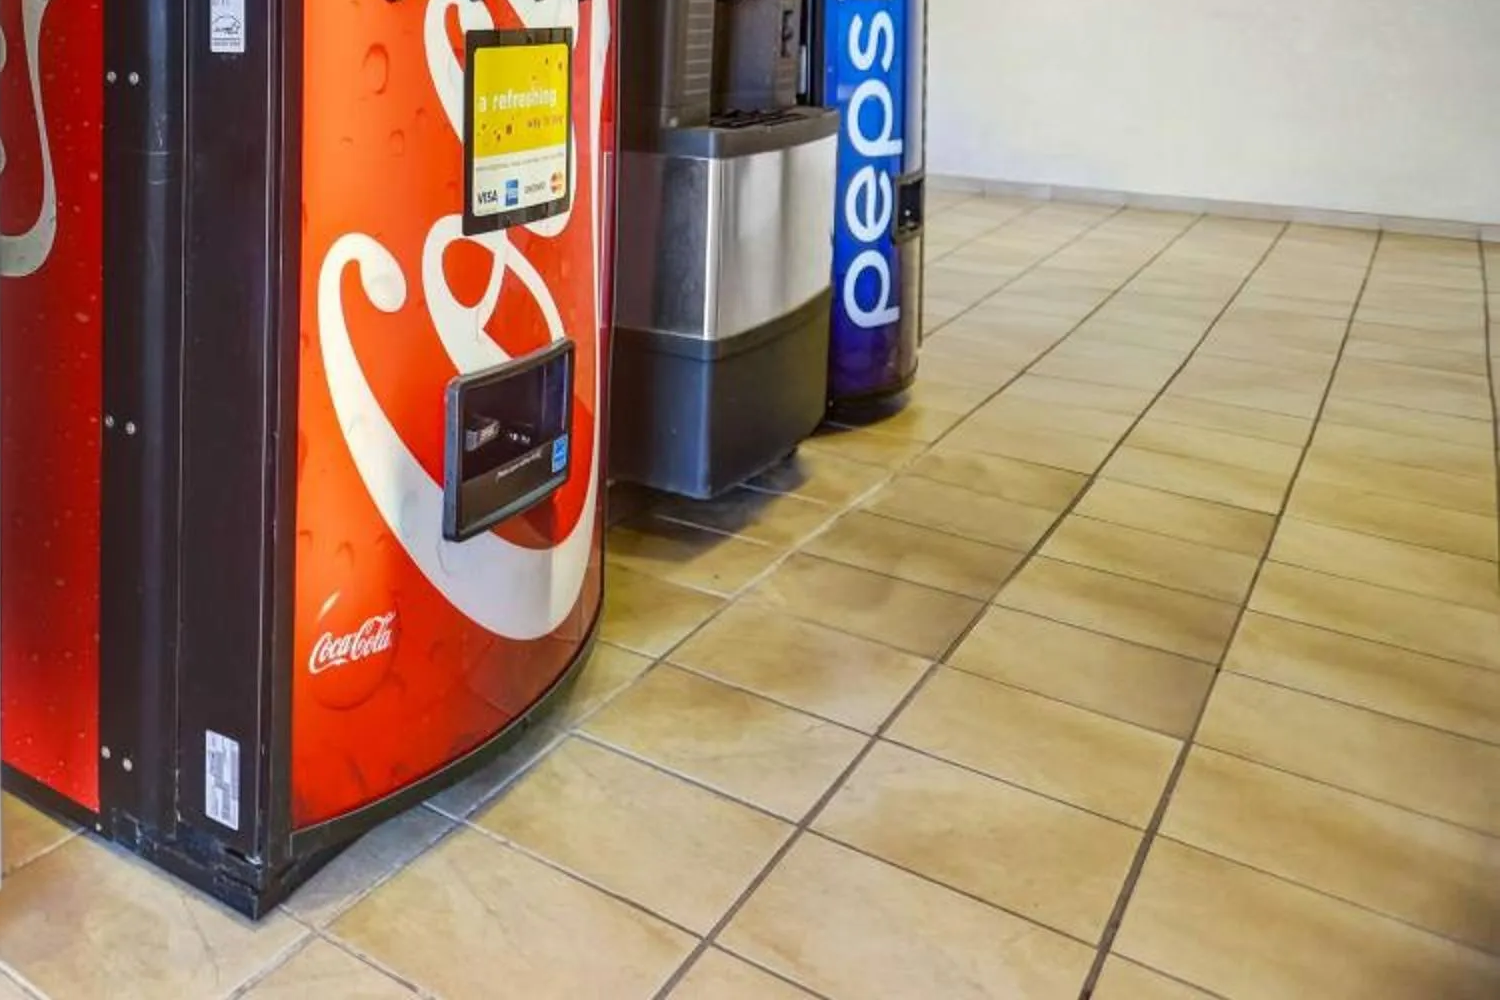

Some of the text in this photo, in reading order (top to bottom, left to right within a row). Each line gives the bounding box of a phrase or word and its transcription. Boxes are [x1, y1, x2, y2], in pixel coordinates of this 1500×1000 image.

[493, 88, 557, 110] refreshing
[478, 189, 498, 204] VISA
[308, 612, 397, 675] Coca-Cola
